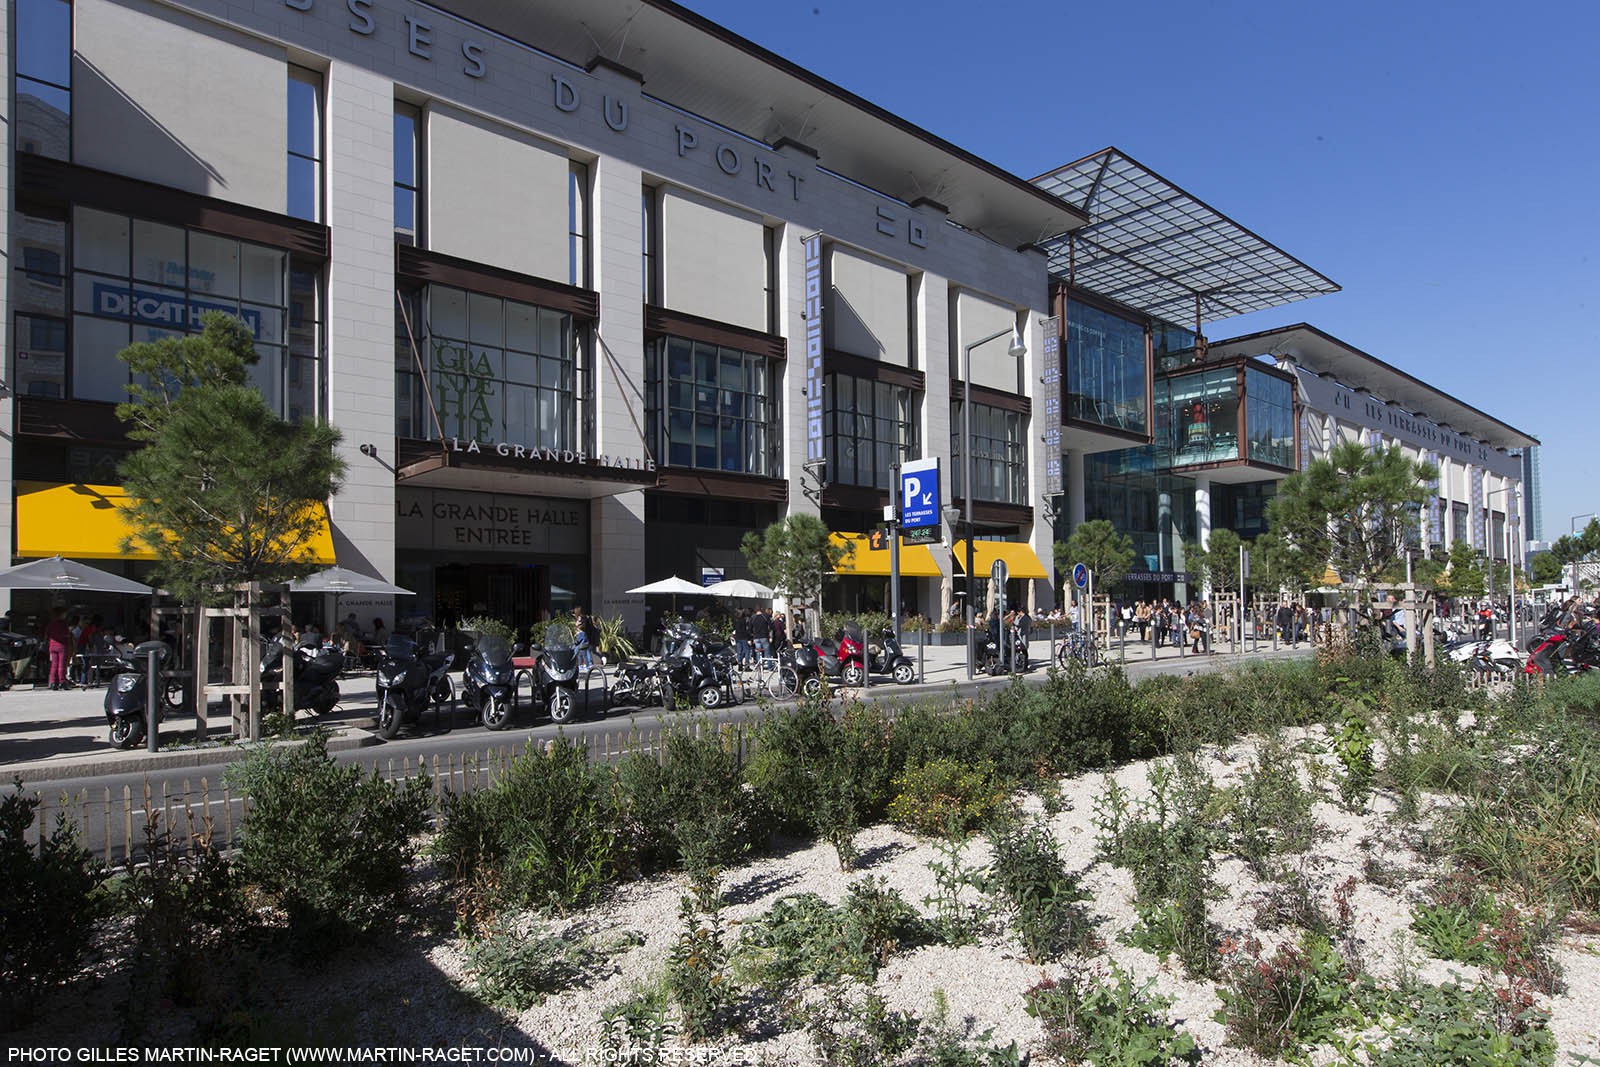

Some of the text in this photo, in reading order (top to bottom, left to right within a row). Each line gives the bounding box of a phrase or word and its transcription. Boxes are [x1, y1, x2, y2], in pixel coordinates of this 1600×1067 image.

[286, 0, 804, 202] SES DU PORT
[452, 437, 481, 454] LA
[497, 442, 587, 465] GRANDE
[904, 477, 921, 508] P
[397, 500, 580, 526] LA GRANDE HALLE
[454, 526, 532, 545] ENTRÉE
